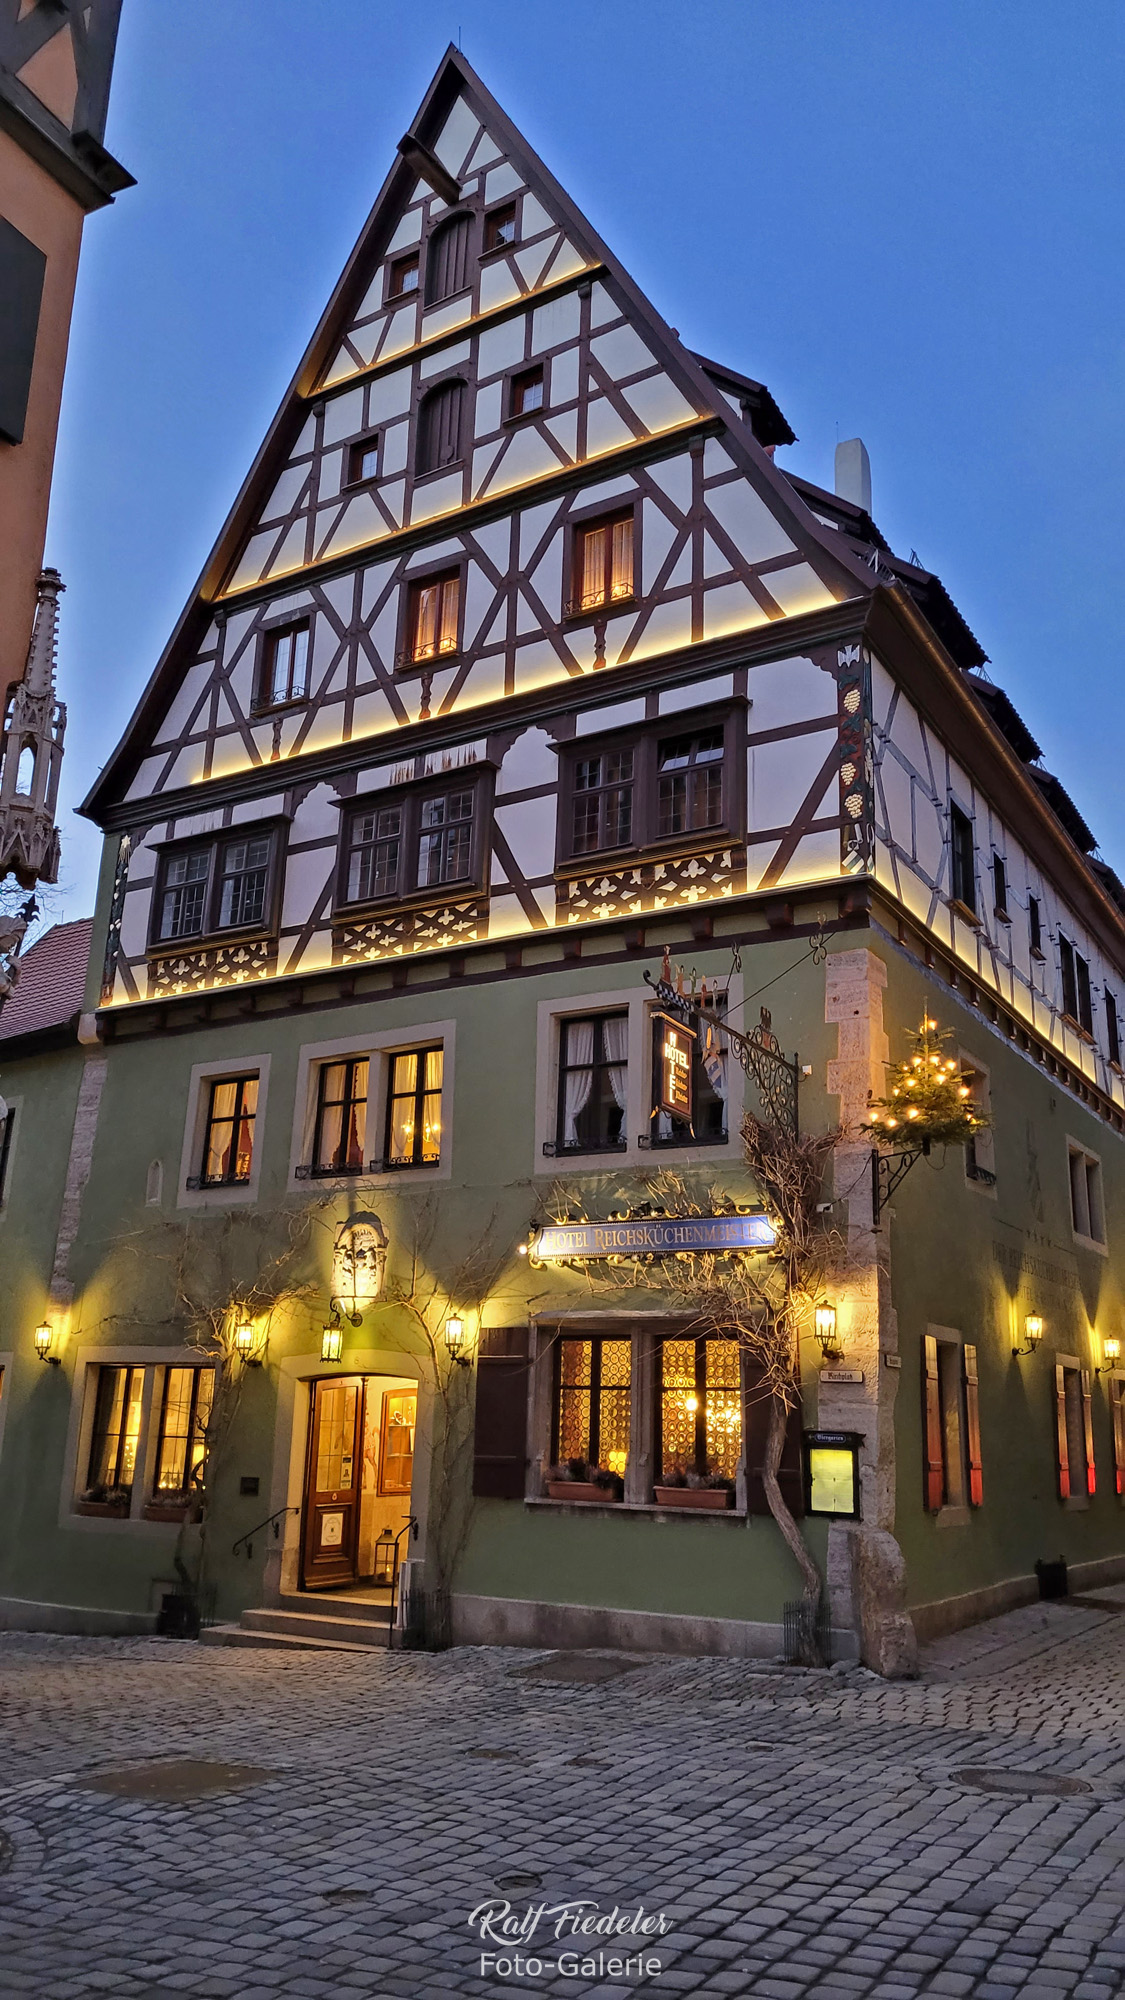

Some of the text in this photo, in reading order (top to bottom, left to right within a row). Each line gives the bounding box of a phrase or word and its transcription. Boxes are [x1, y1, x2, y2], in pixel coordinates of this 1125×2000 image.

[664, 1042, 690, 1070] HOTEL
[669, 1032, 677, 1104] HOTEL
[546, 1222, 768, 1249] HOTEL REICHSKÜCHENMEISTER
